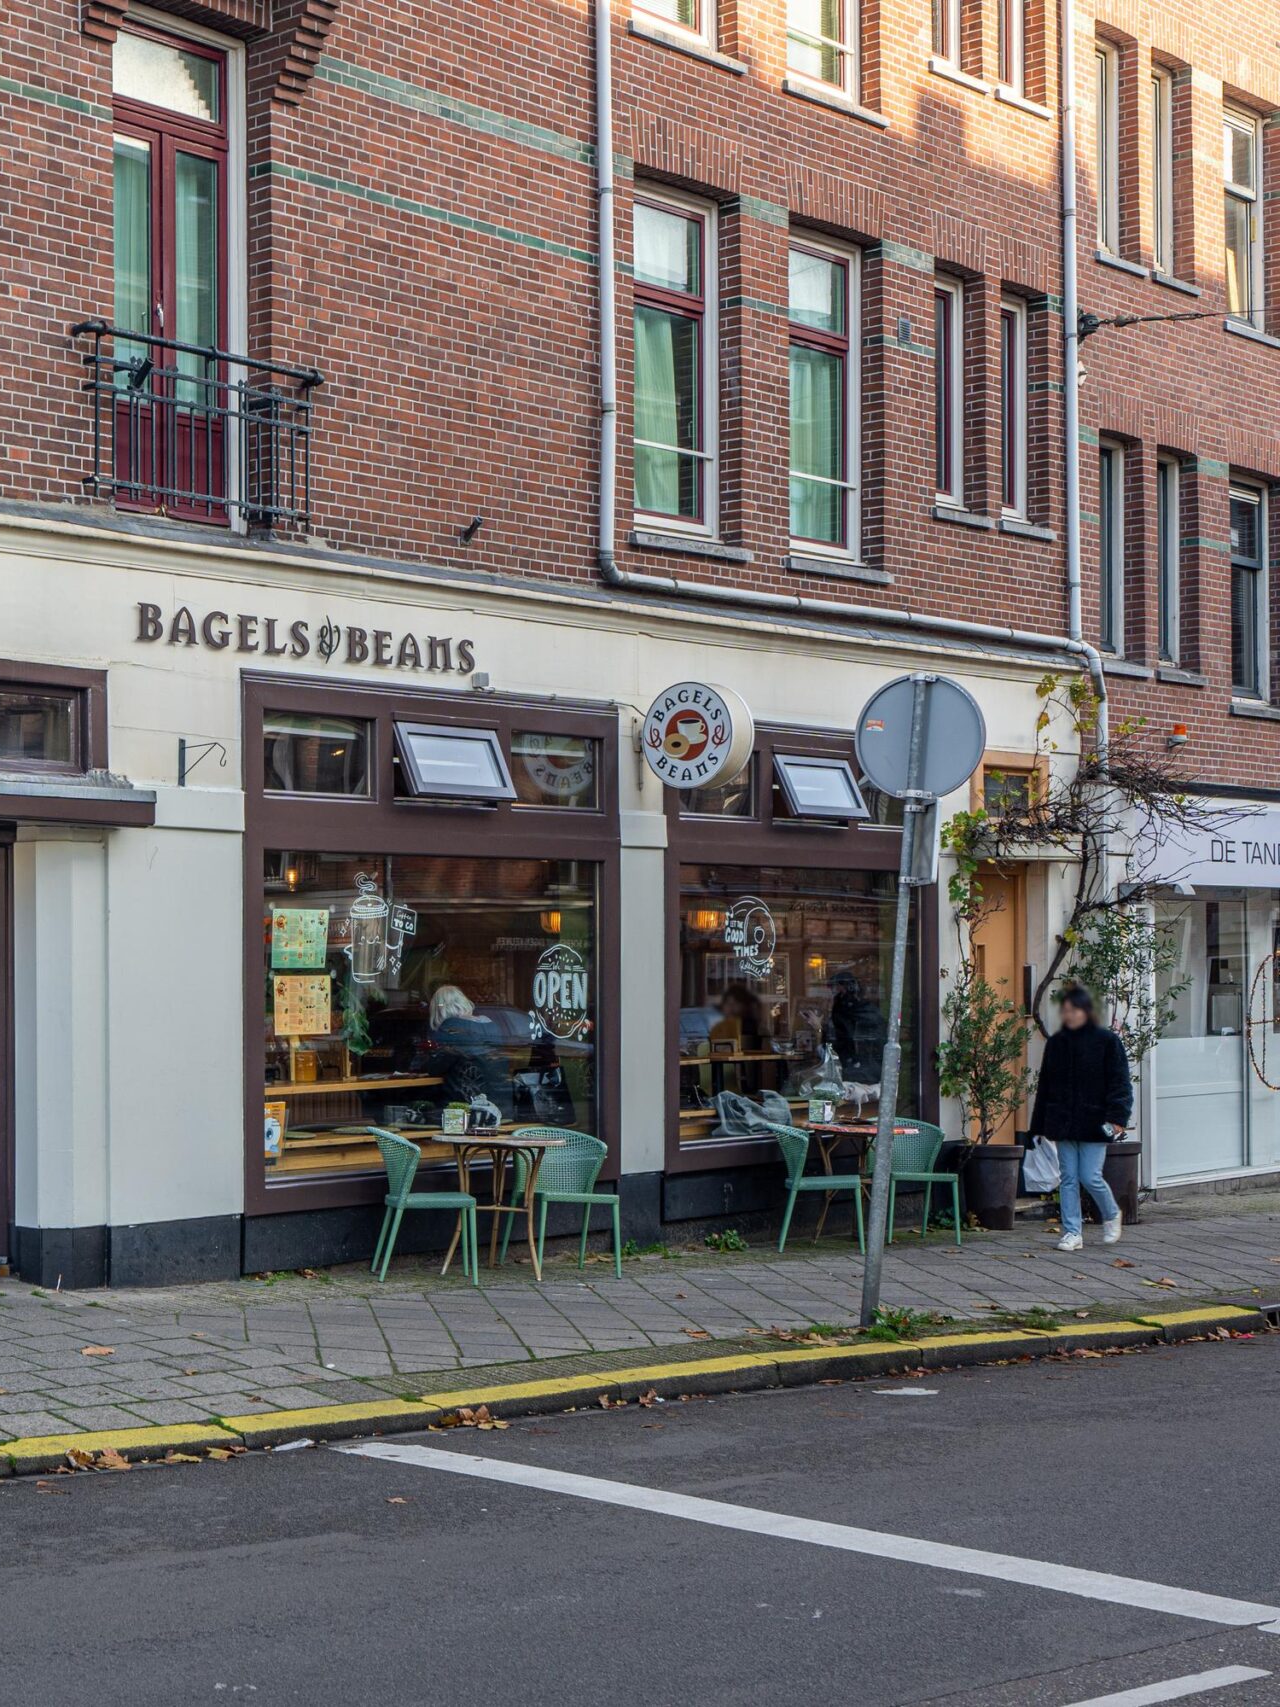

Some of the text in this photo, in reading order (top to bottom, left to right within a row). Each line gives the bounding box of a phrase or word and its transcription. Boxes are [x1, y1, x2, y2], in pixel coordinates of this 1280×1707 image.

[136, 601, 311, 658] BAGELS
[346, 626, 476, 674] BEANS
[653, 689, 722, 723] BAGELS
[656, 752, 719, 781] BEANS
[1211, 839, 1280, 866] DE TAN
[725, 927, 744, 944] GOOD
[733, 944, 759, 957] TIMES
[532, 970, 588, 1010] OPEN
